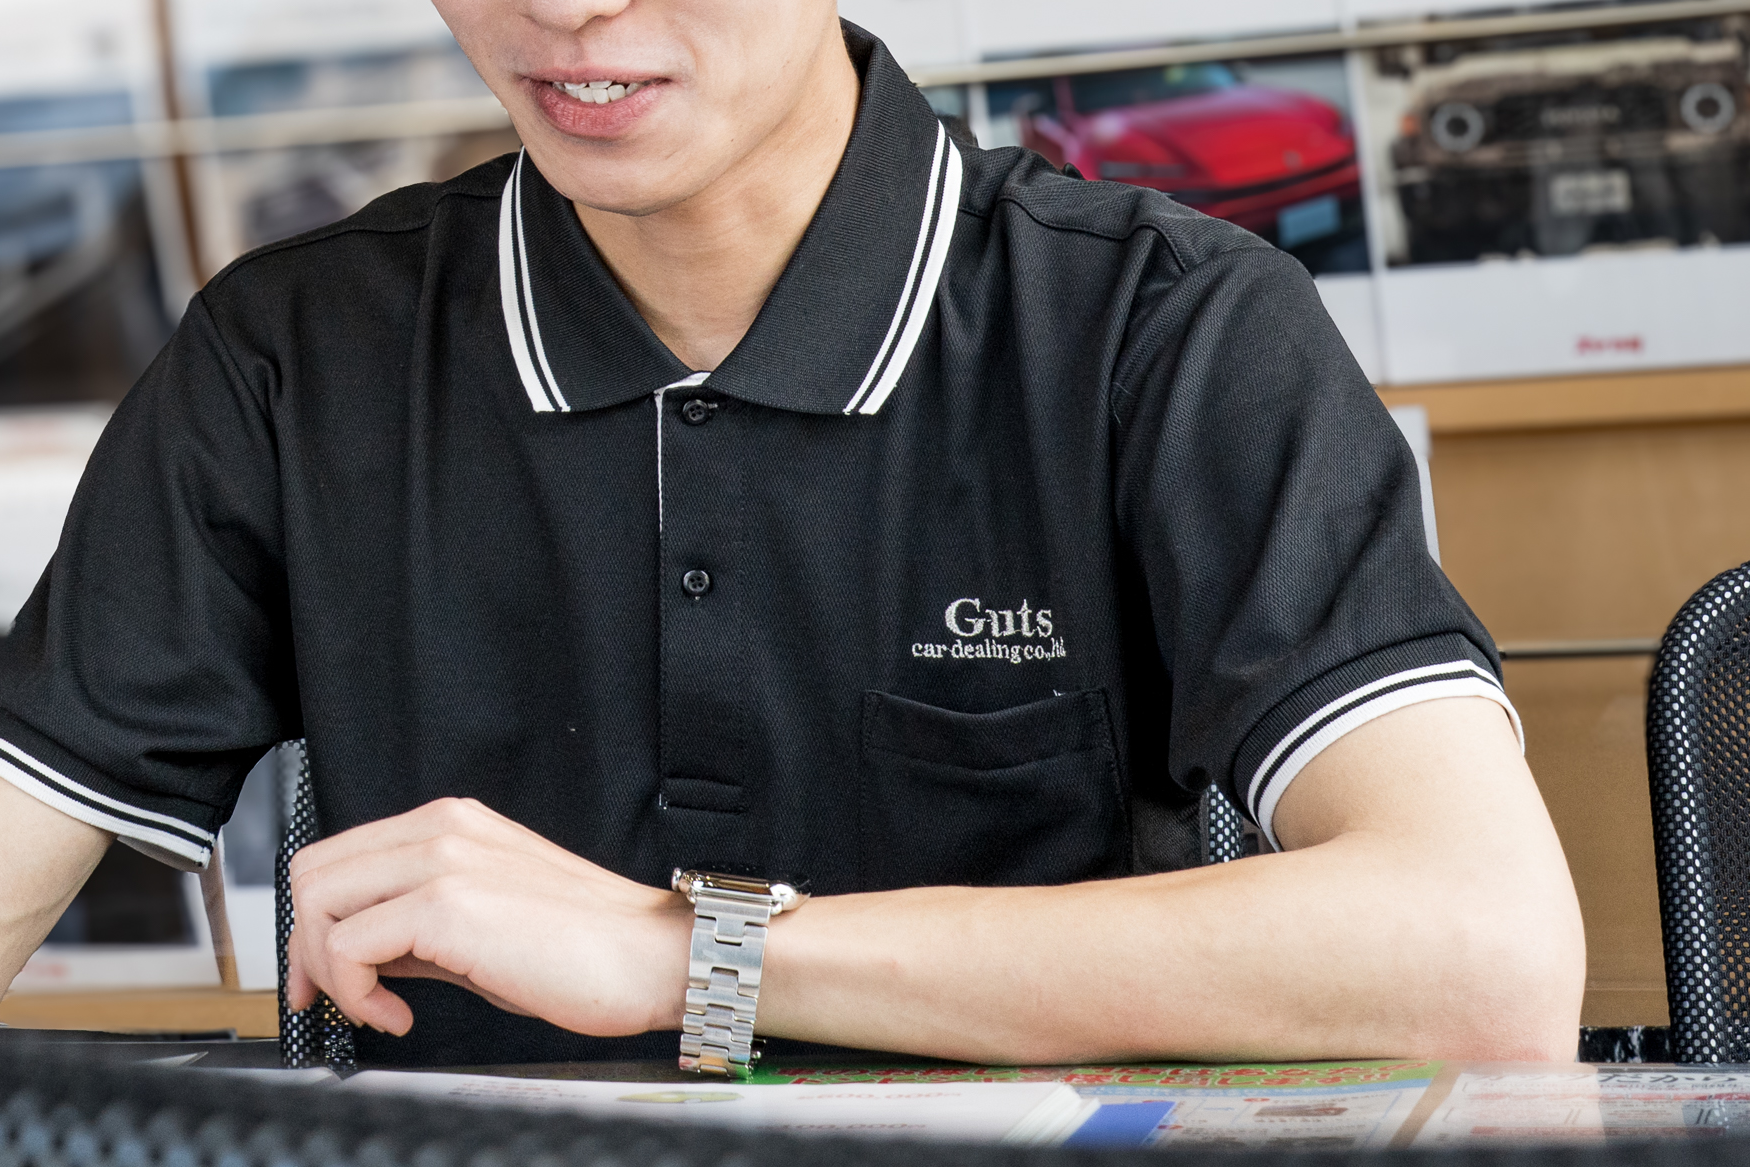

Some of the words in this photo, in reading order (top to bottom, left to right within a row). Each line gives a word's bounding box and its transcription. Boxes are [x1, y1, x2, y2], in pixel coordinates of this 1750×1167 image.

[945, 597, 1053, 637] Guts
[911, 642, 947, 658] car
[951, 638, 1022, 664] dealing
